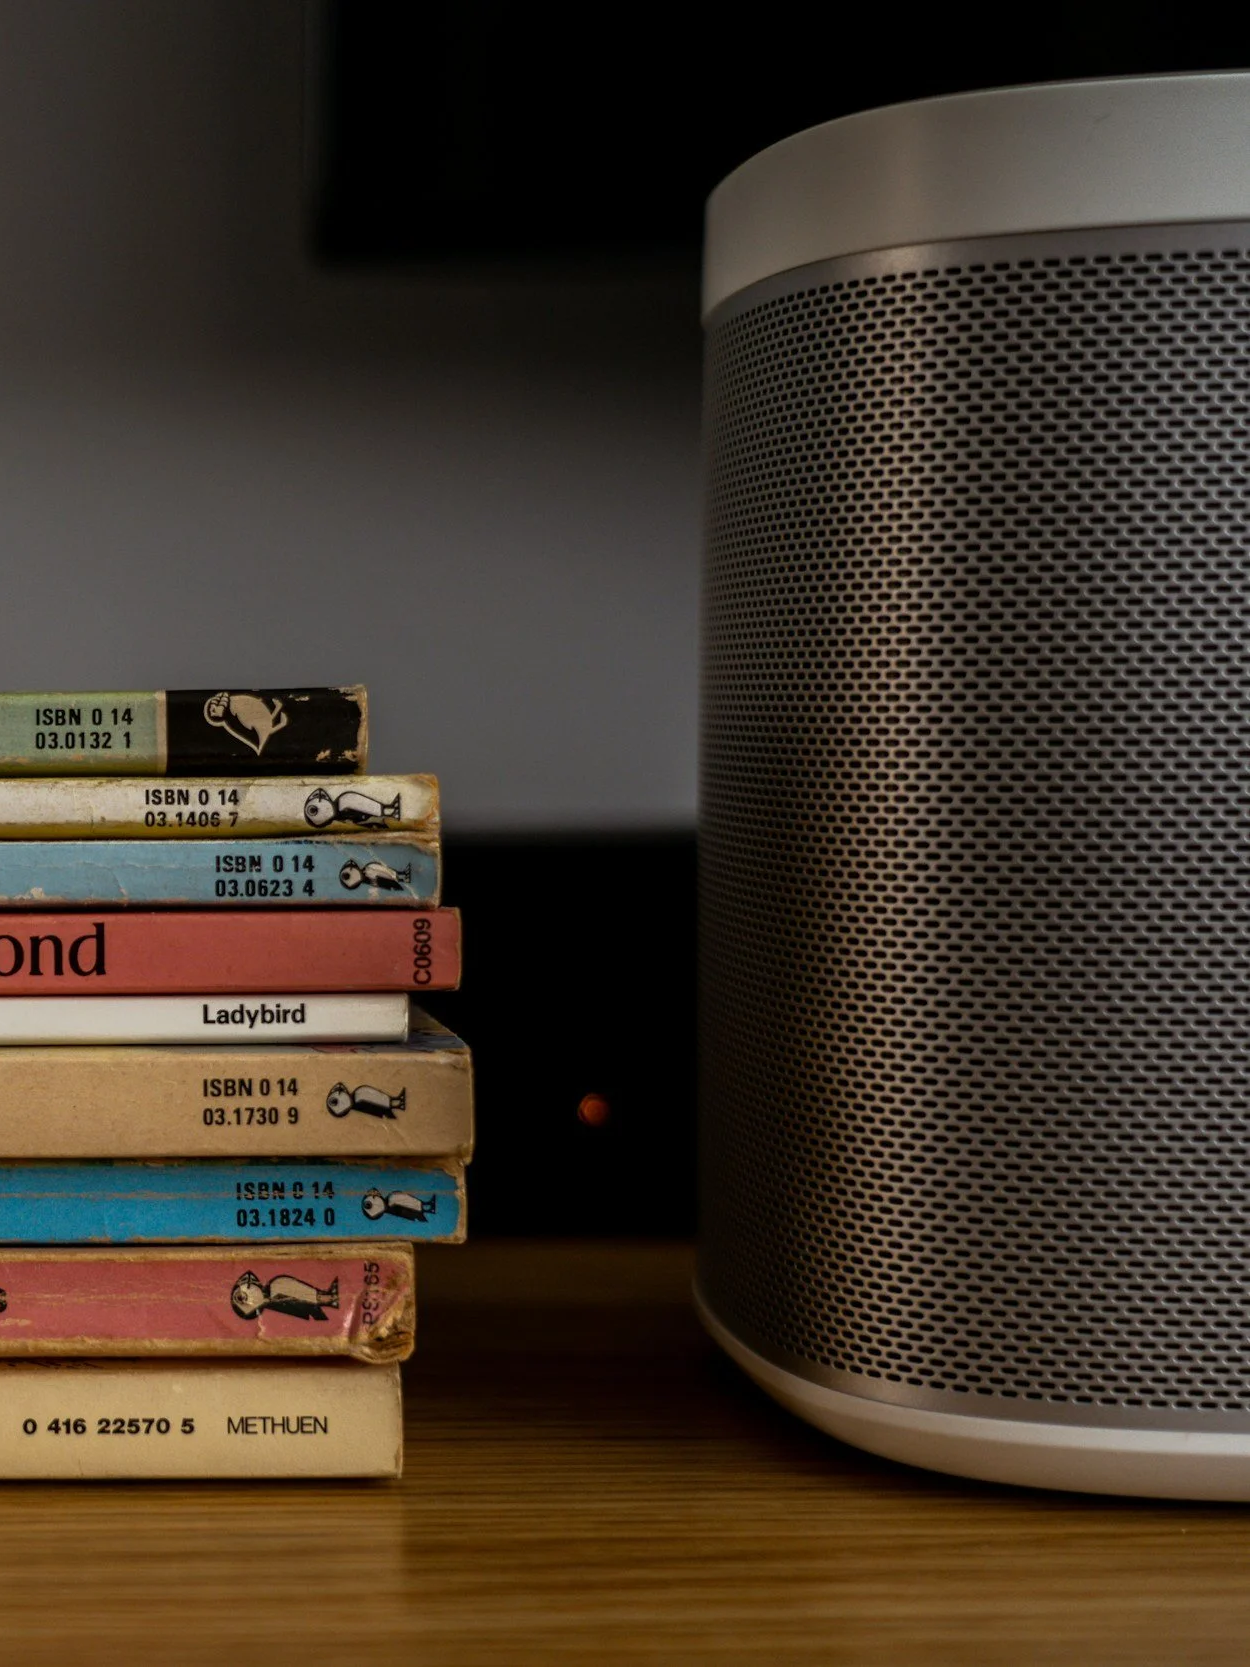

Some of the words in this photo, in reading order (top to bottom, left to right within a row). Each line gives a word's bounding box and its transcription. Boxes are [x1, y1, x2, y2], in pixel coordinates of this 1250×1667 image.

[35, 709, 81, 727] ISBN
[92, 709, 103, 726] 0
[111, 708, 134, 726] 14
[35, 731, 112, 750] 03.0132
[123, 731, 132, 749] 1
[145, 789, 190, 806] ISBN
[199, 789, 209, 806] 0
[216, 788, 239, 806] 14
[144, 812, 221, 828] 03.1406
[228, 811, 239, 828] 7
[216, 856, 261, 873] ISBN
[273, 856, 283, 873] 0
[291, 856, 314, 873] 14
[215, 879, 294, 897] 03.0623
[302, 879, 315, 897] 4
[203, 1004, 306, 1028] Ladybird
[203, 1079, 252, 1097] ISBN
[260, 1079, 271, 1096] 0
[277, 1078, 299, 1096] 14
[203, 1108, 279, 1126] 03.1730
[288, 1107, 299, 1124] 9
[236, 1182, 285, 1201] ISBN
[312, 1182, 335, 1199] 14
[236, 1208, 315, 1227] 03.1824
[324, 1208, 335, 1226] 0
[23, 1419, 37, 1435] 0
[47, 1418, 86, 1435] 416
[97, 1418, 170, 1435] 22570
[180, 1418, 194, 1434] 5
[227, 1416, 328, 1435] METHUEN
